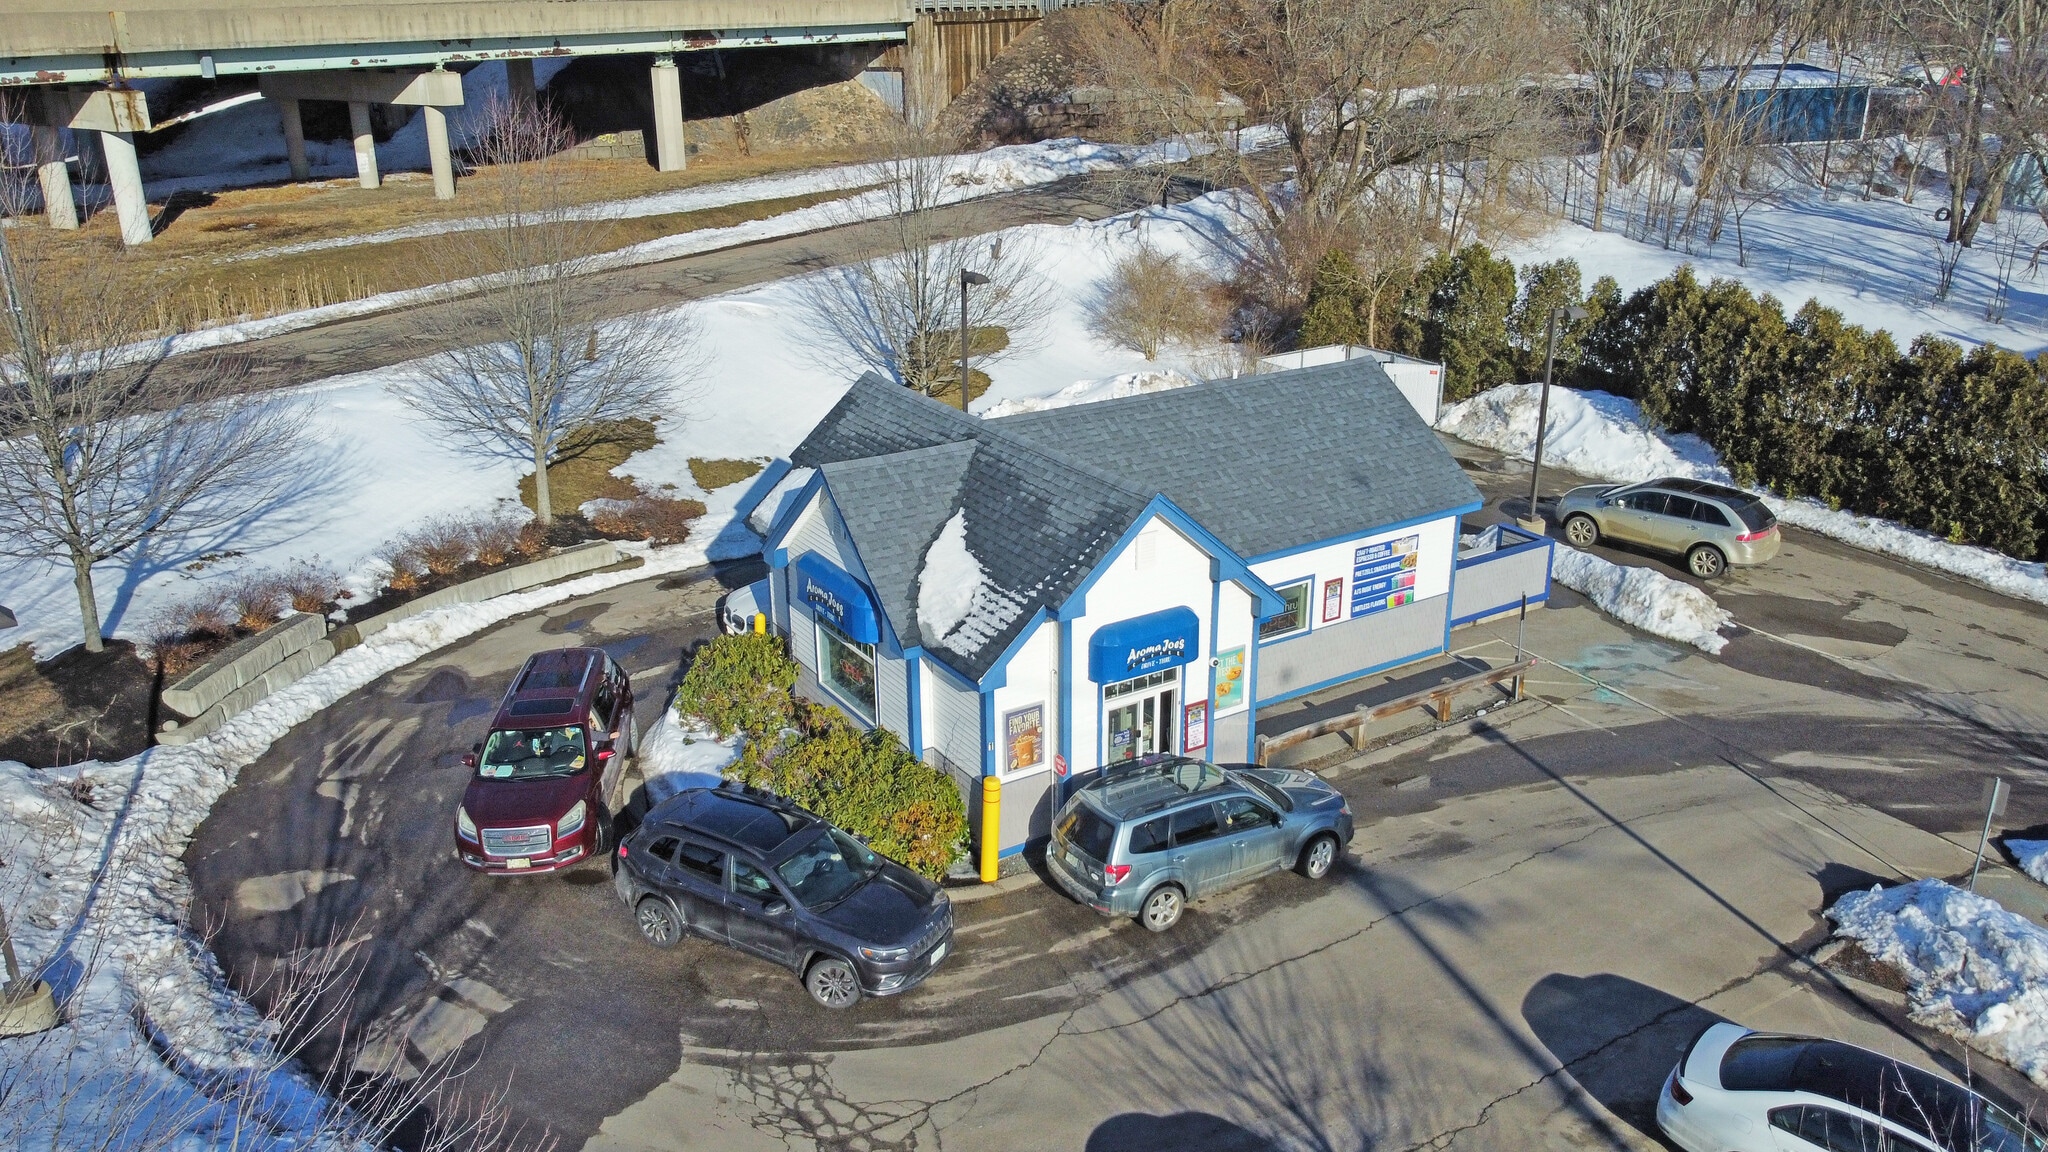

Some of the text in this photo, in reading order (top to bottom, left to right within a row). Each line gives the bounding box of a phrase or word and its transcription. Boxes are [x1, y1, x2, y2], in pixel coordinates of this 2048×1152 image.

[1356, 554, 1374, 563] ESPRESSO
[1374, 564, 1387, 573] SNACKS
[806, 577, 828, 601] Aroma
[1373, 582, 1386, 590] ENERGY
[1353, 599, 1386, 612] LIMITLESS FLAVORS
[1126, 644, 1162, 664] Aroma
[1132, 650, 1180, 668] COFFEE
[1225, 655, 1237, 667] THE
[1009, 715, 1022, 727] FIND
[1023, 711, 1040, 722] YOUR
[1009, 719, 1040, 736] FAVORITE
